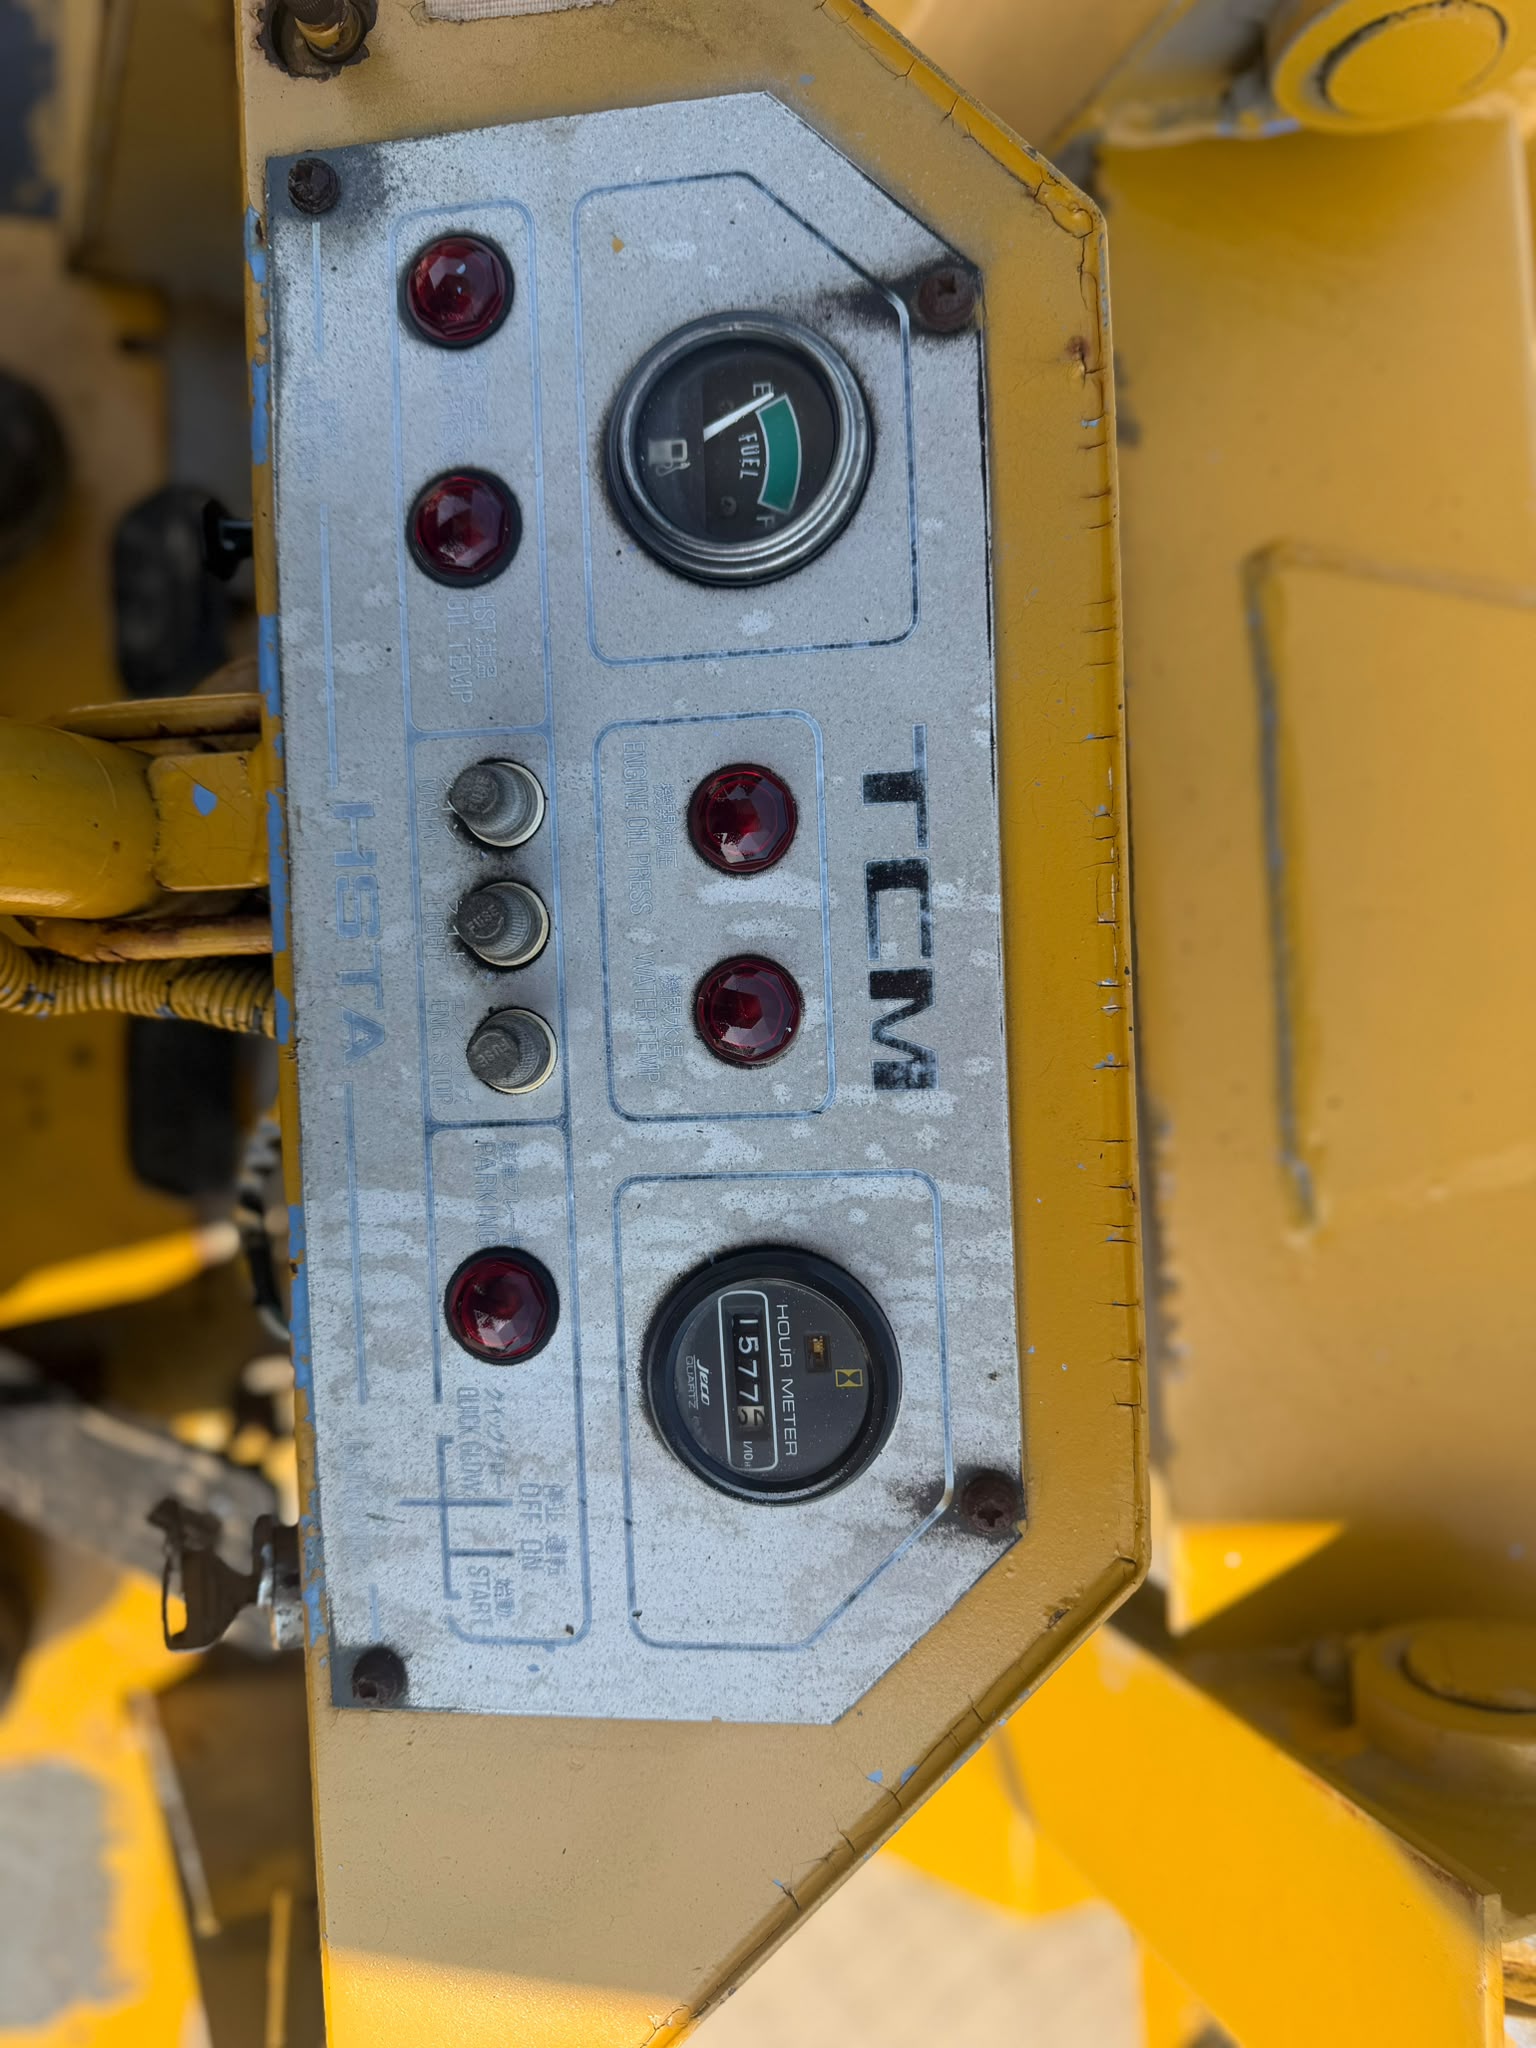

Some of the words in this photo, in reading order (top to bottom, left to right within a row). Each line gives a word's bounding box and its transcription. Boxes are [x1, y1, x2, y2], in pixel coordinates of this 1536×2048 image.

[751, 382, 773, 398] E
[737, 433, 759, 480] FUEL
[755, 515, 773, 528] F
[446, 596, 470, 633] OIL
[448, 638, 472, 704] TEMP
[621, 741, 648, 812] ENGINE
[417, 777, 439, 842] MAIN
[625, 816, 649, 848] OIL
[652, 783, 677, 869] 機関油圧
[626, 853, 652, 916] PRESS
[860, 723, 937, 1092] TCM
[333, 801, 384, 1066] HSTA
[423, 900, 445, 962] LIGHT
[631, 952, 657, 1022] WATER
[659, 974, 683, 1060] 機関水温
[429, 1053, 452, 1106] STOP
[635, 1027, 660, 1083] TEMP
[472, 1142, 499, 1248] PARKING
[775, 1304, 791, 1368] HOUR
[456, 1387, 480, 1440] QUICK
[684, 1356, 695, 1409] QUARTZ
[780, 1378, 797, 1456] METER
[457, 1441, 483, 1493] GLOW
[517, 1482, 542, 1526] OFF
[519, 1538, 543, 1571] ON
[467, 1564, 492, 1628] START
